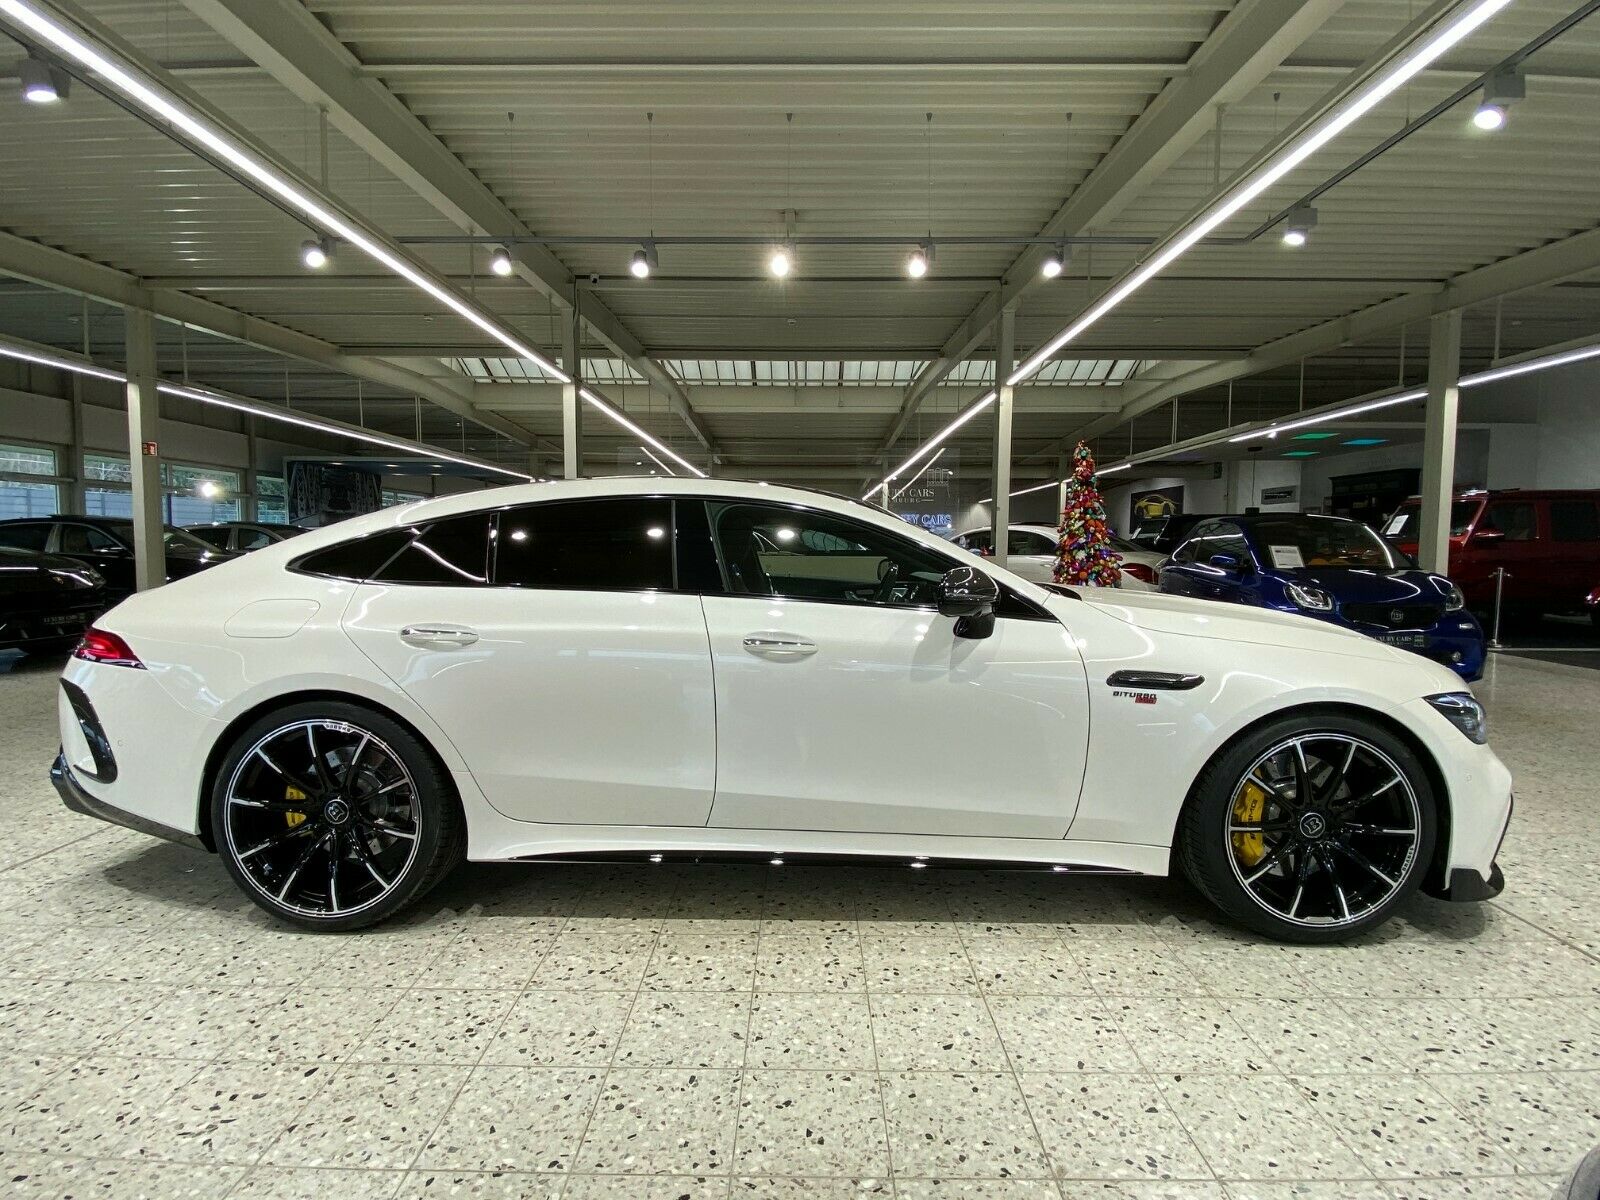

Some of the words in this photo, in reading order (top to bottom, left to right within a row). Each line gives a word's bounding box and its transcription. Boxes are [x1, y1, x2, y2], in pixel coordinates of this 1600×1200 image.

[909, 488, 935, 498] CARS
[921, 513, 952, 525] CARS
[1112, 690, 1157, 700] BITURBO
